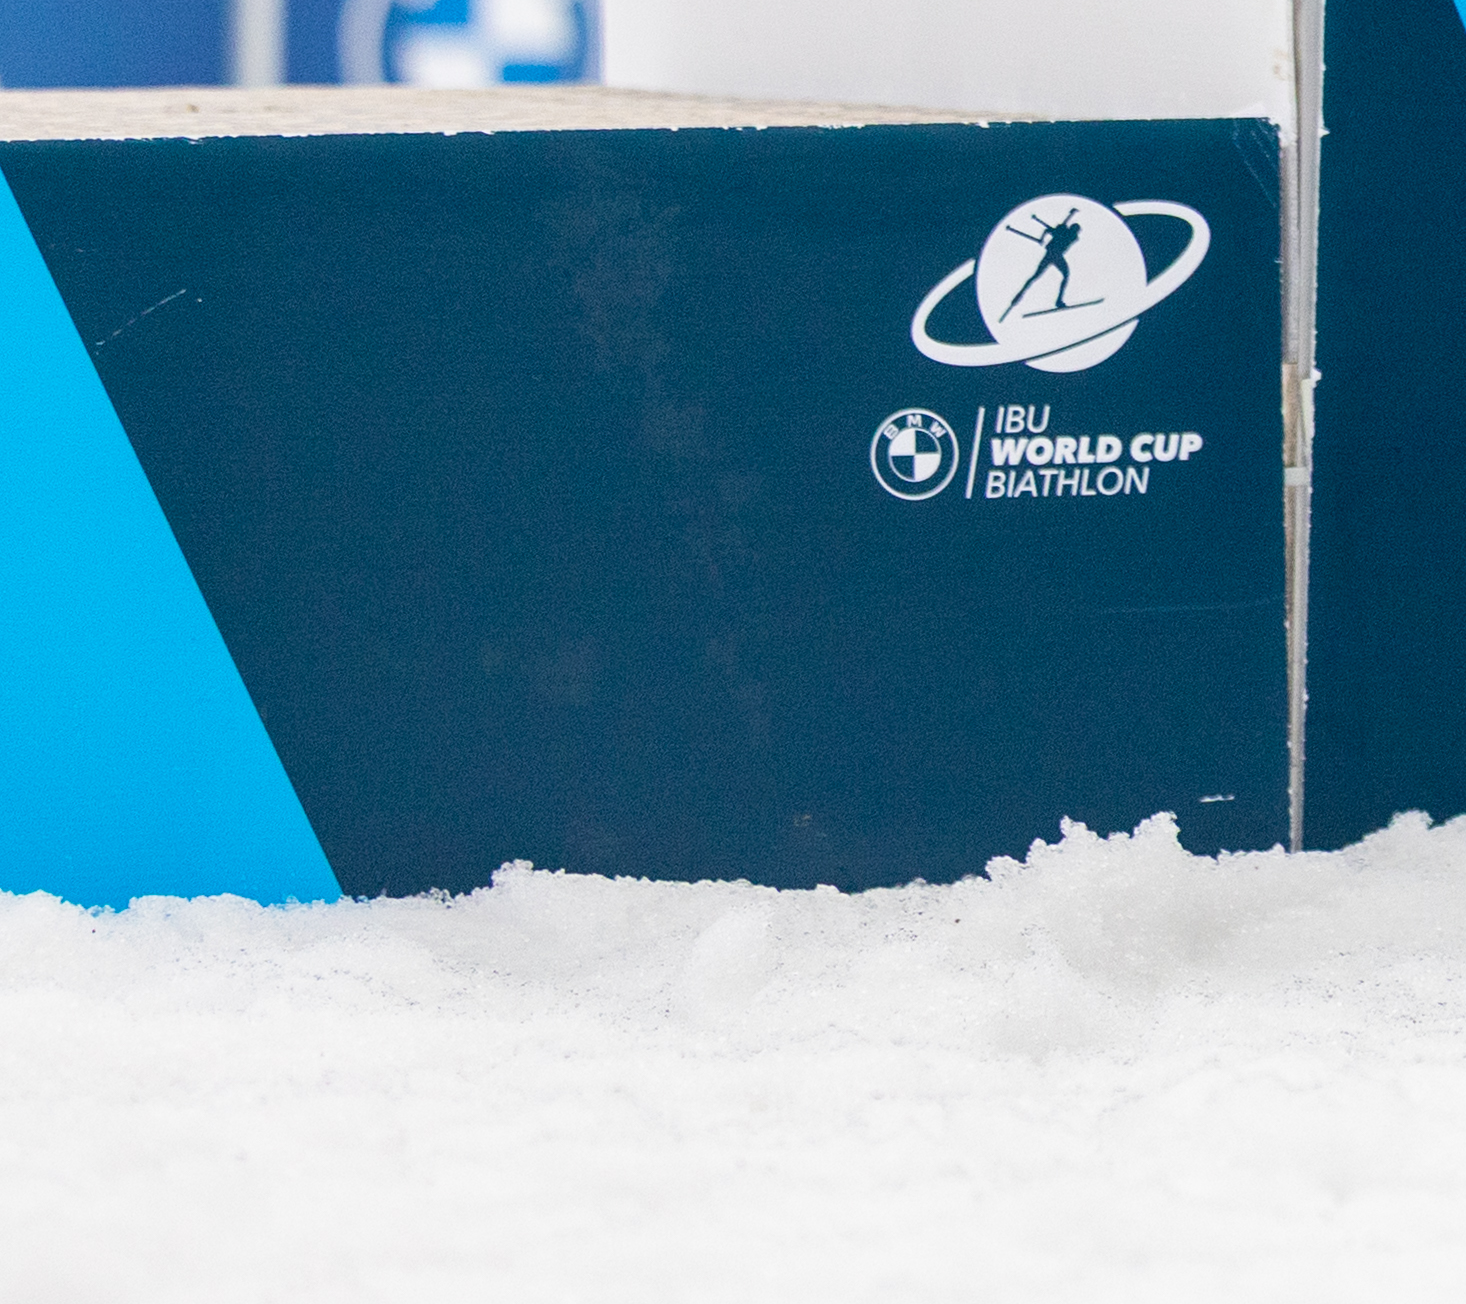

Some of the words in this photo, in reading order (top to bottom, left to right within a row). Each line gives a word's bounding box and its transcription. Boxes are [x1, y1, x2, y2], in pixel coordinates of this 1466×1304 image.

[883, 414, 947, 440] BMW
[995, 405, 1051, 434] IBU
[991, 435, 1123, 466] WORLD
[1130, 433, 1203, 463] CUP
[985, 467, 1151, 499] BIATHLON
